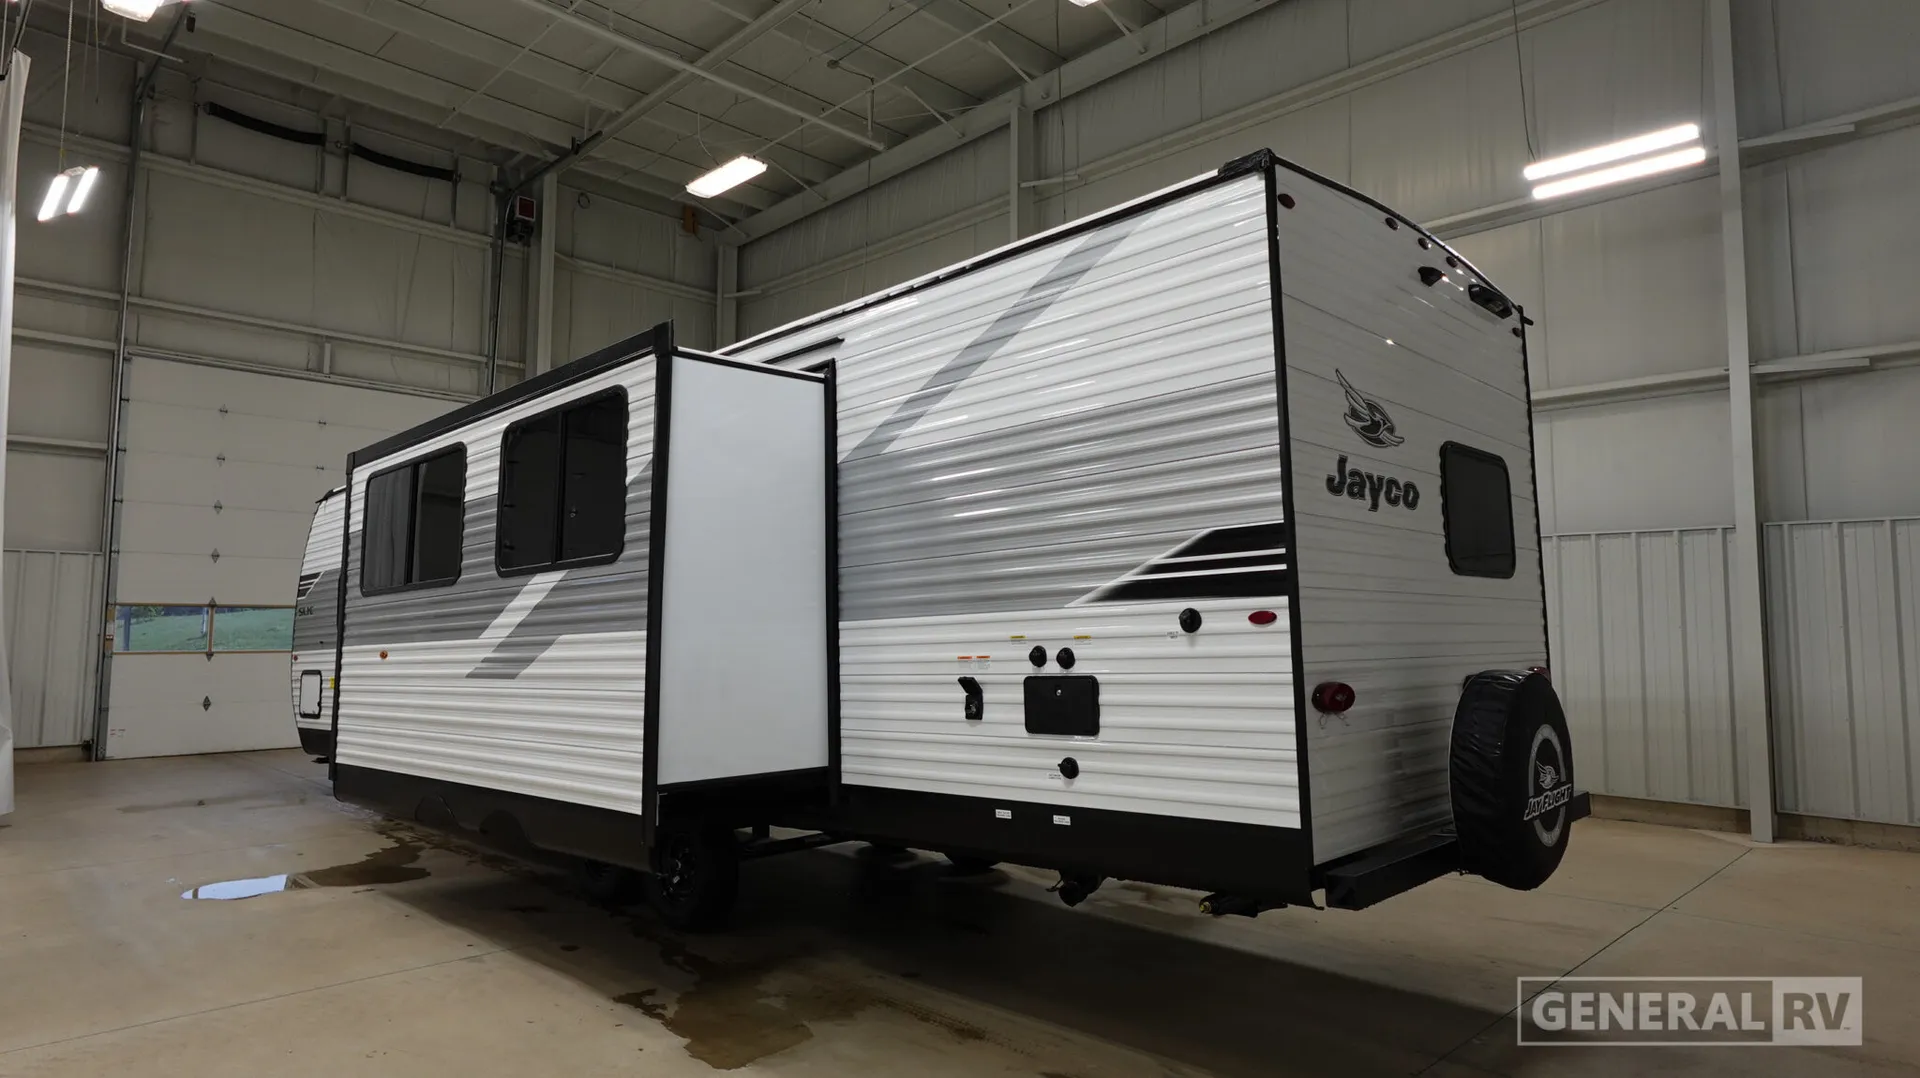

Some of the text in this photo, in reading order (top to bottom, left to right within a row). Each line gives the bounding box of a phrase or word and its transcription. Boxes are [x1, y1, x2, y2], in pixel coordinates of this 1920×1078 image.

[1326, 454, 1420, 512] Jayco
[1523, 784, 1572, 820] JAY FLIGHT
